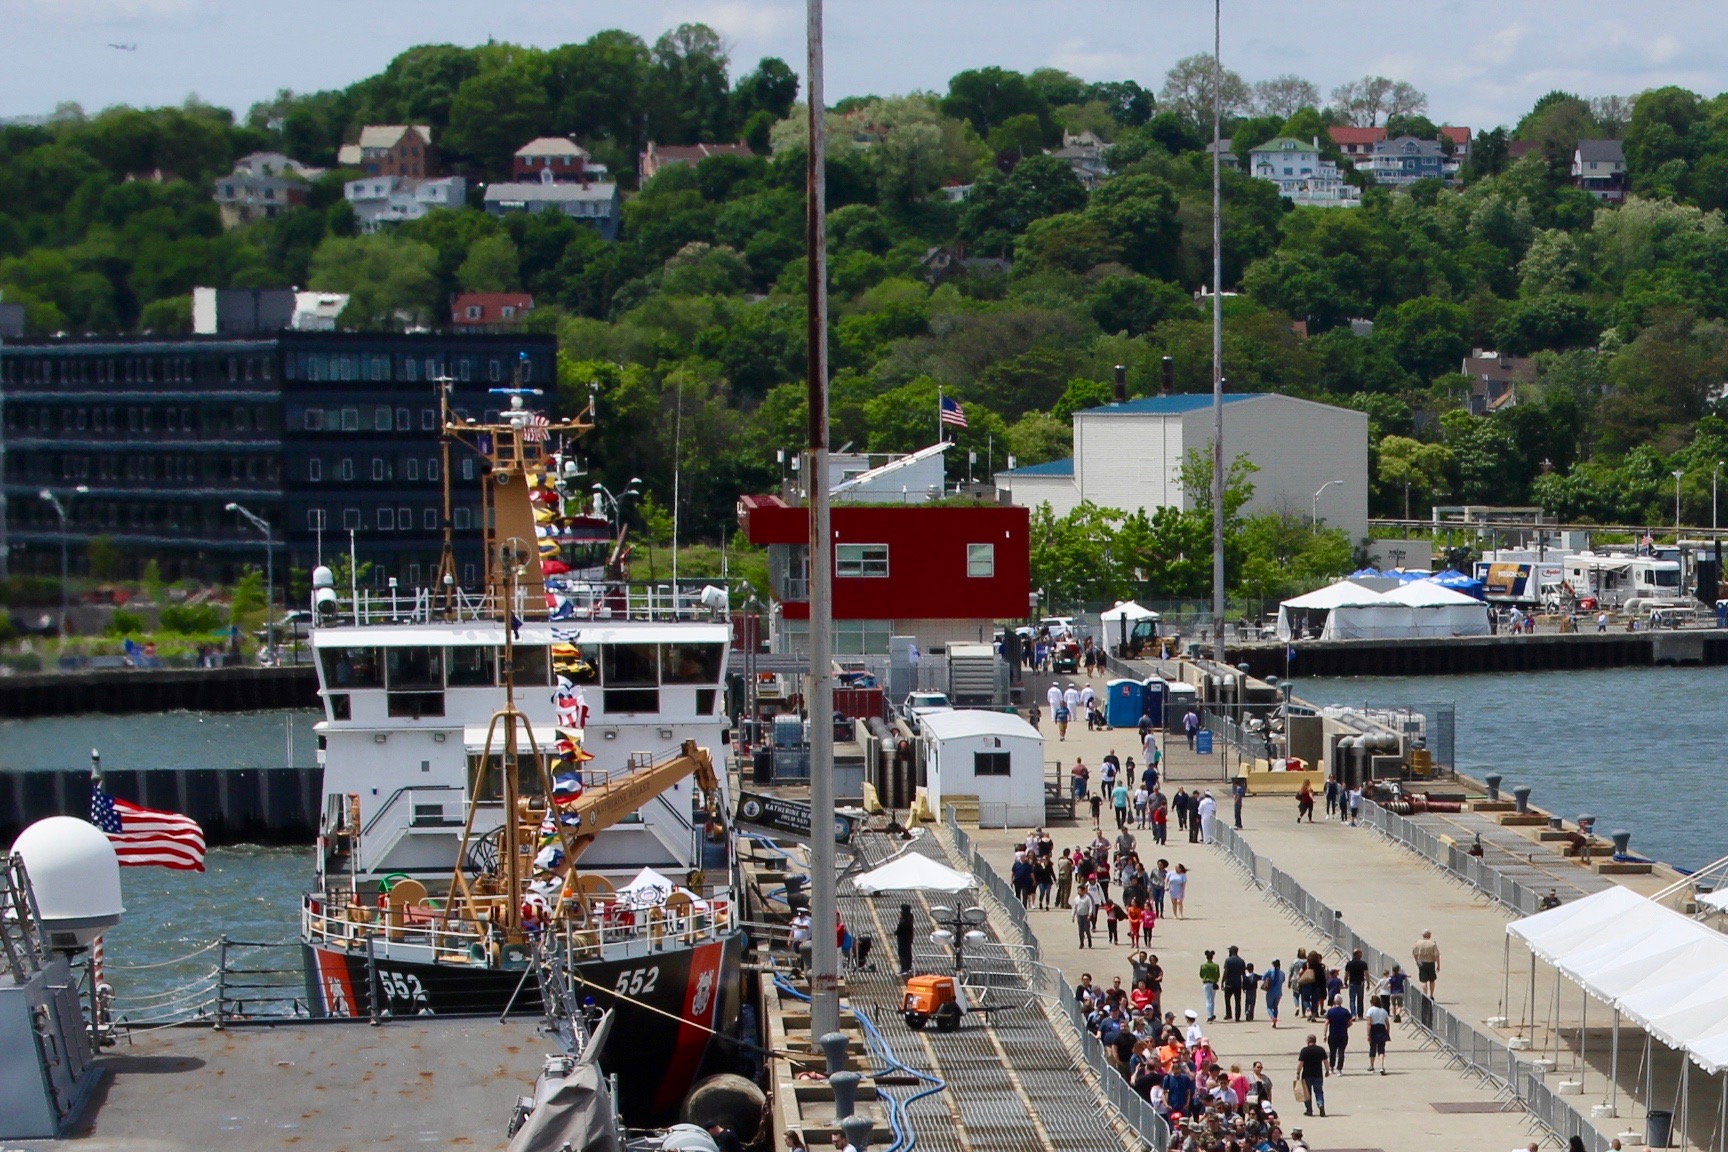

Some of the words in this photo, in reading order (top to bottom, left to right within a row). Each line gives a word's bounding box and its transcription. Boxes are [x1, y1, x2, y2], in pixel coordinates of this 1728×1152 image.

[765, 803, 800, 817] KATHERINE
[801, 811, 812, 820] WA
[378, 969, 428, 1002] 552
[614, 966, 660, 997] 552
